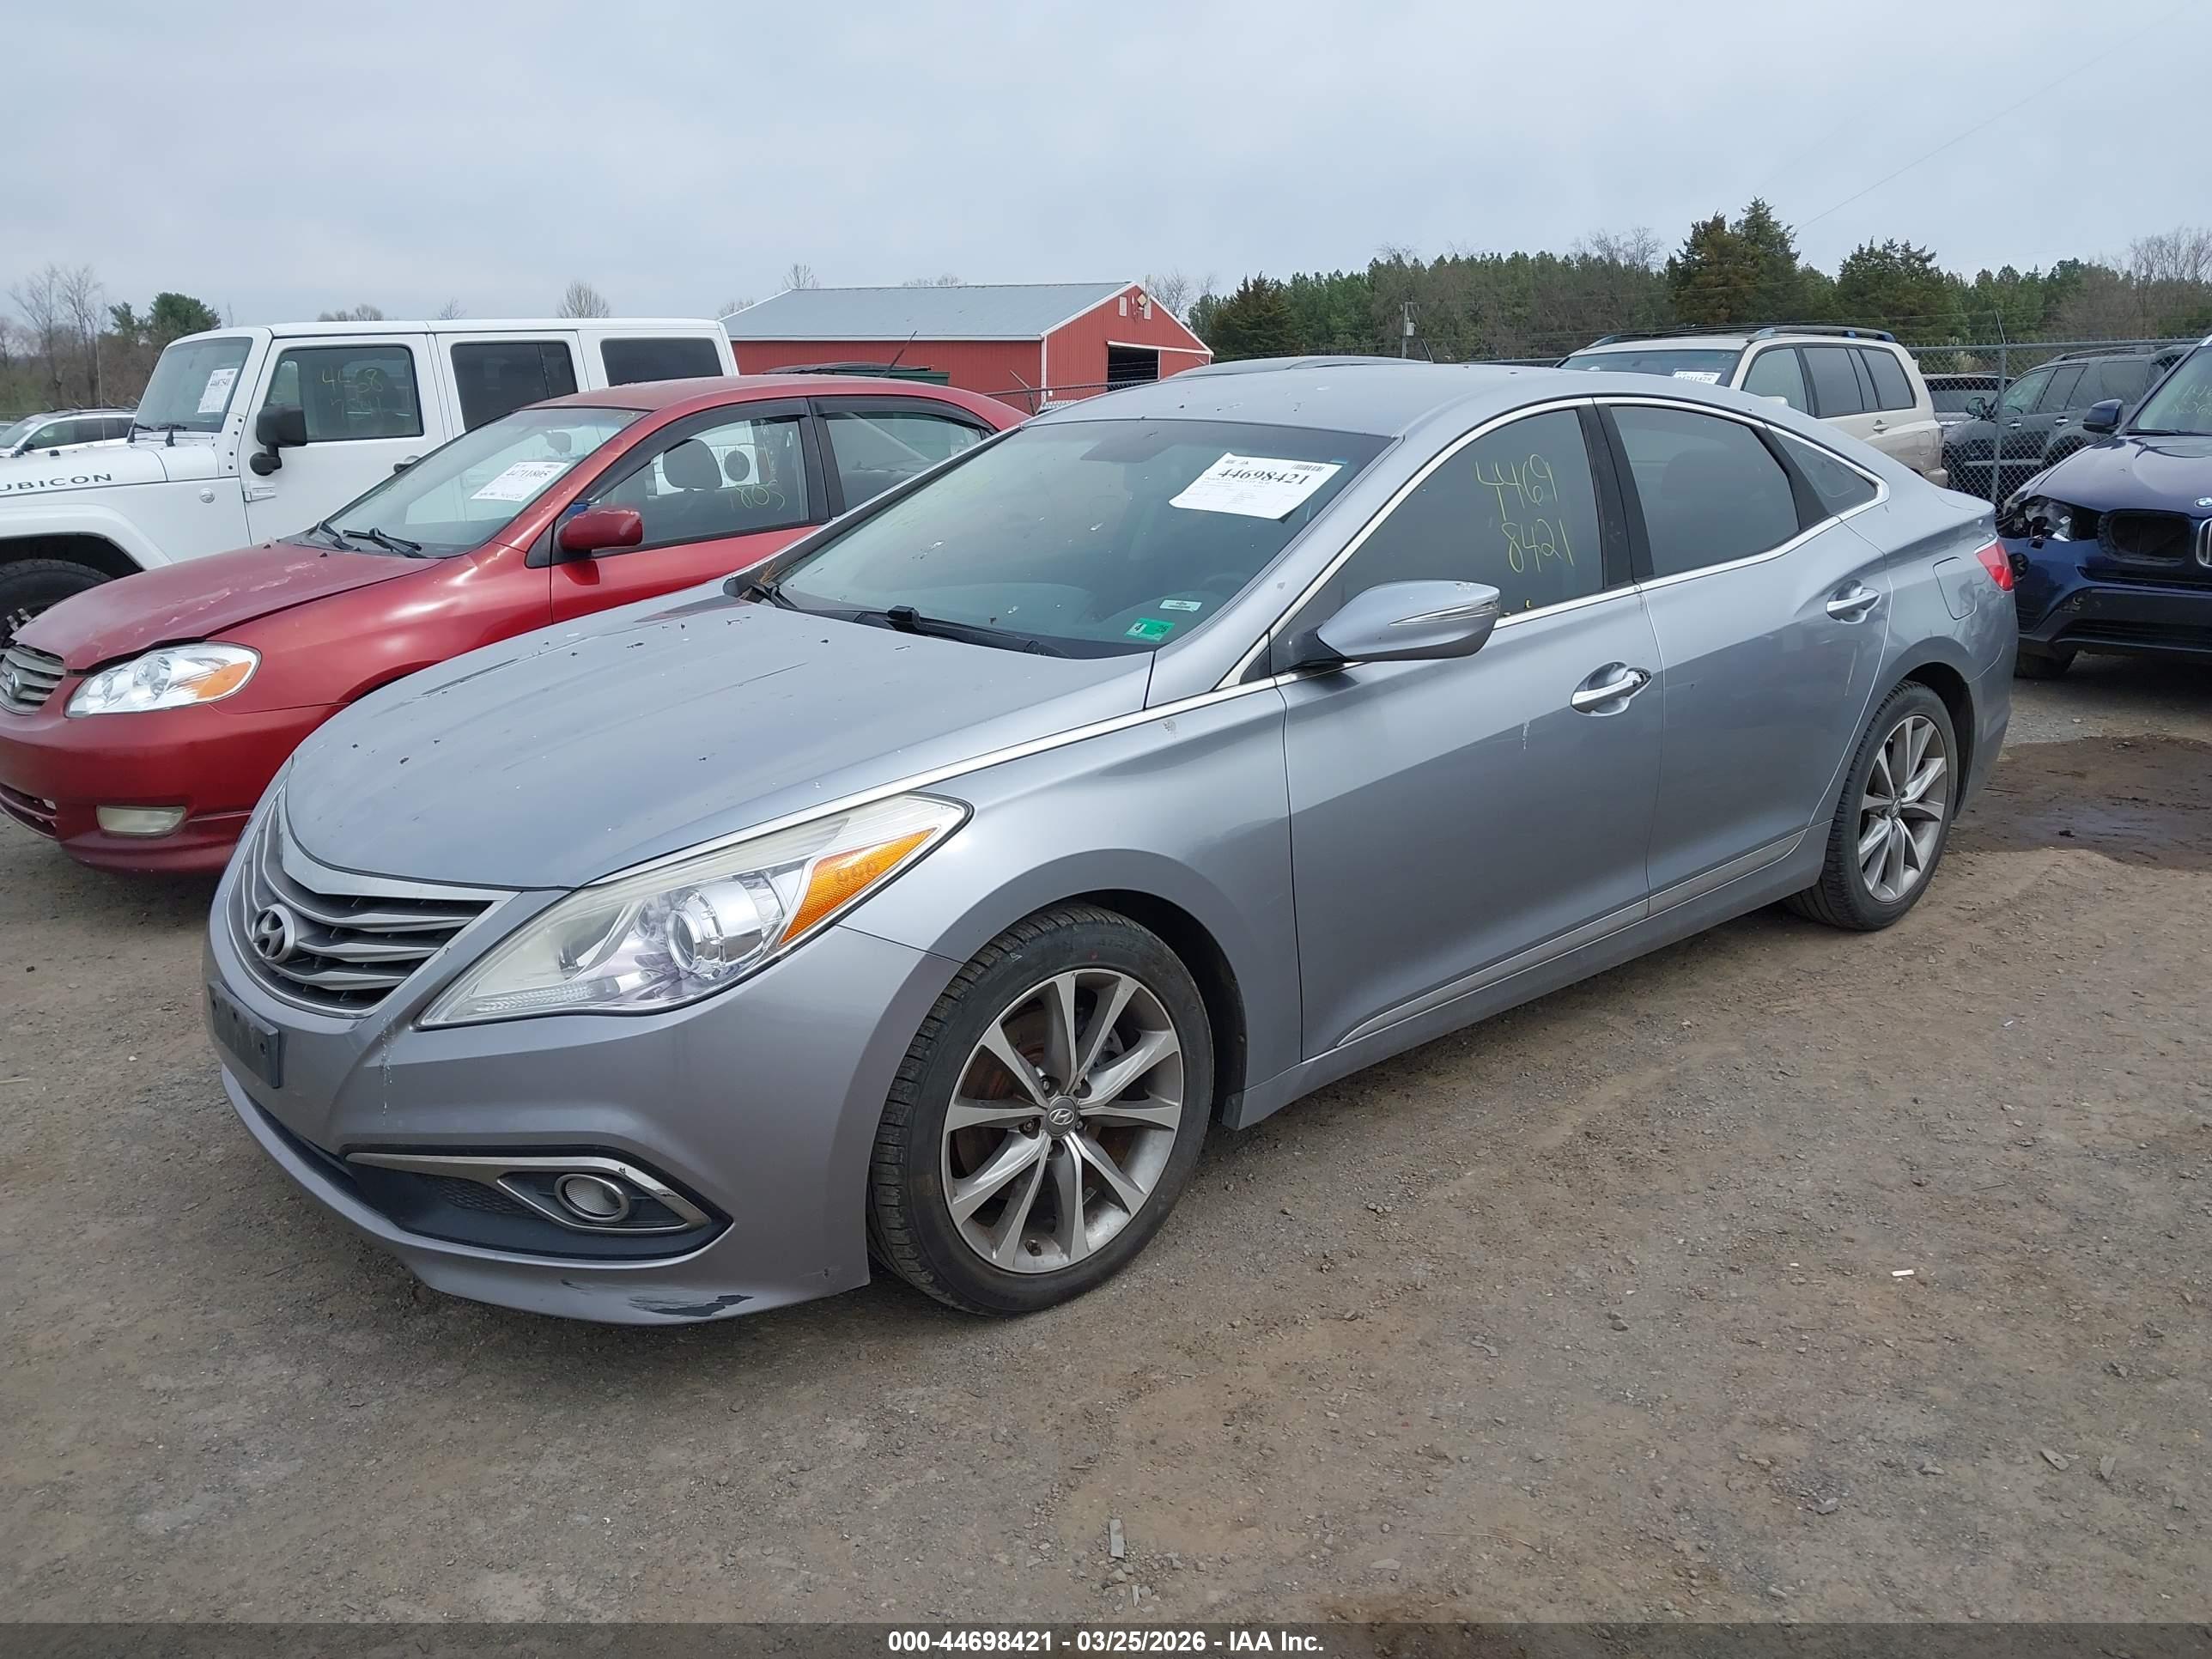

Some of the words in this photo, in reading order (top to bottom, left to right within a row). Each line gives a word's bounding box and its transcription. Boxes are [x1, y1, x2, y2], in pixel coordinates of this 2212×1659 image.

[1218, 468, 1310, 485] 44698421
[1474, 453, 1559, 521] 4469
[1501, 518, 1575, 573] 8421
